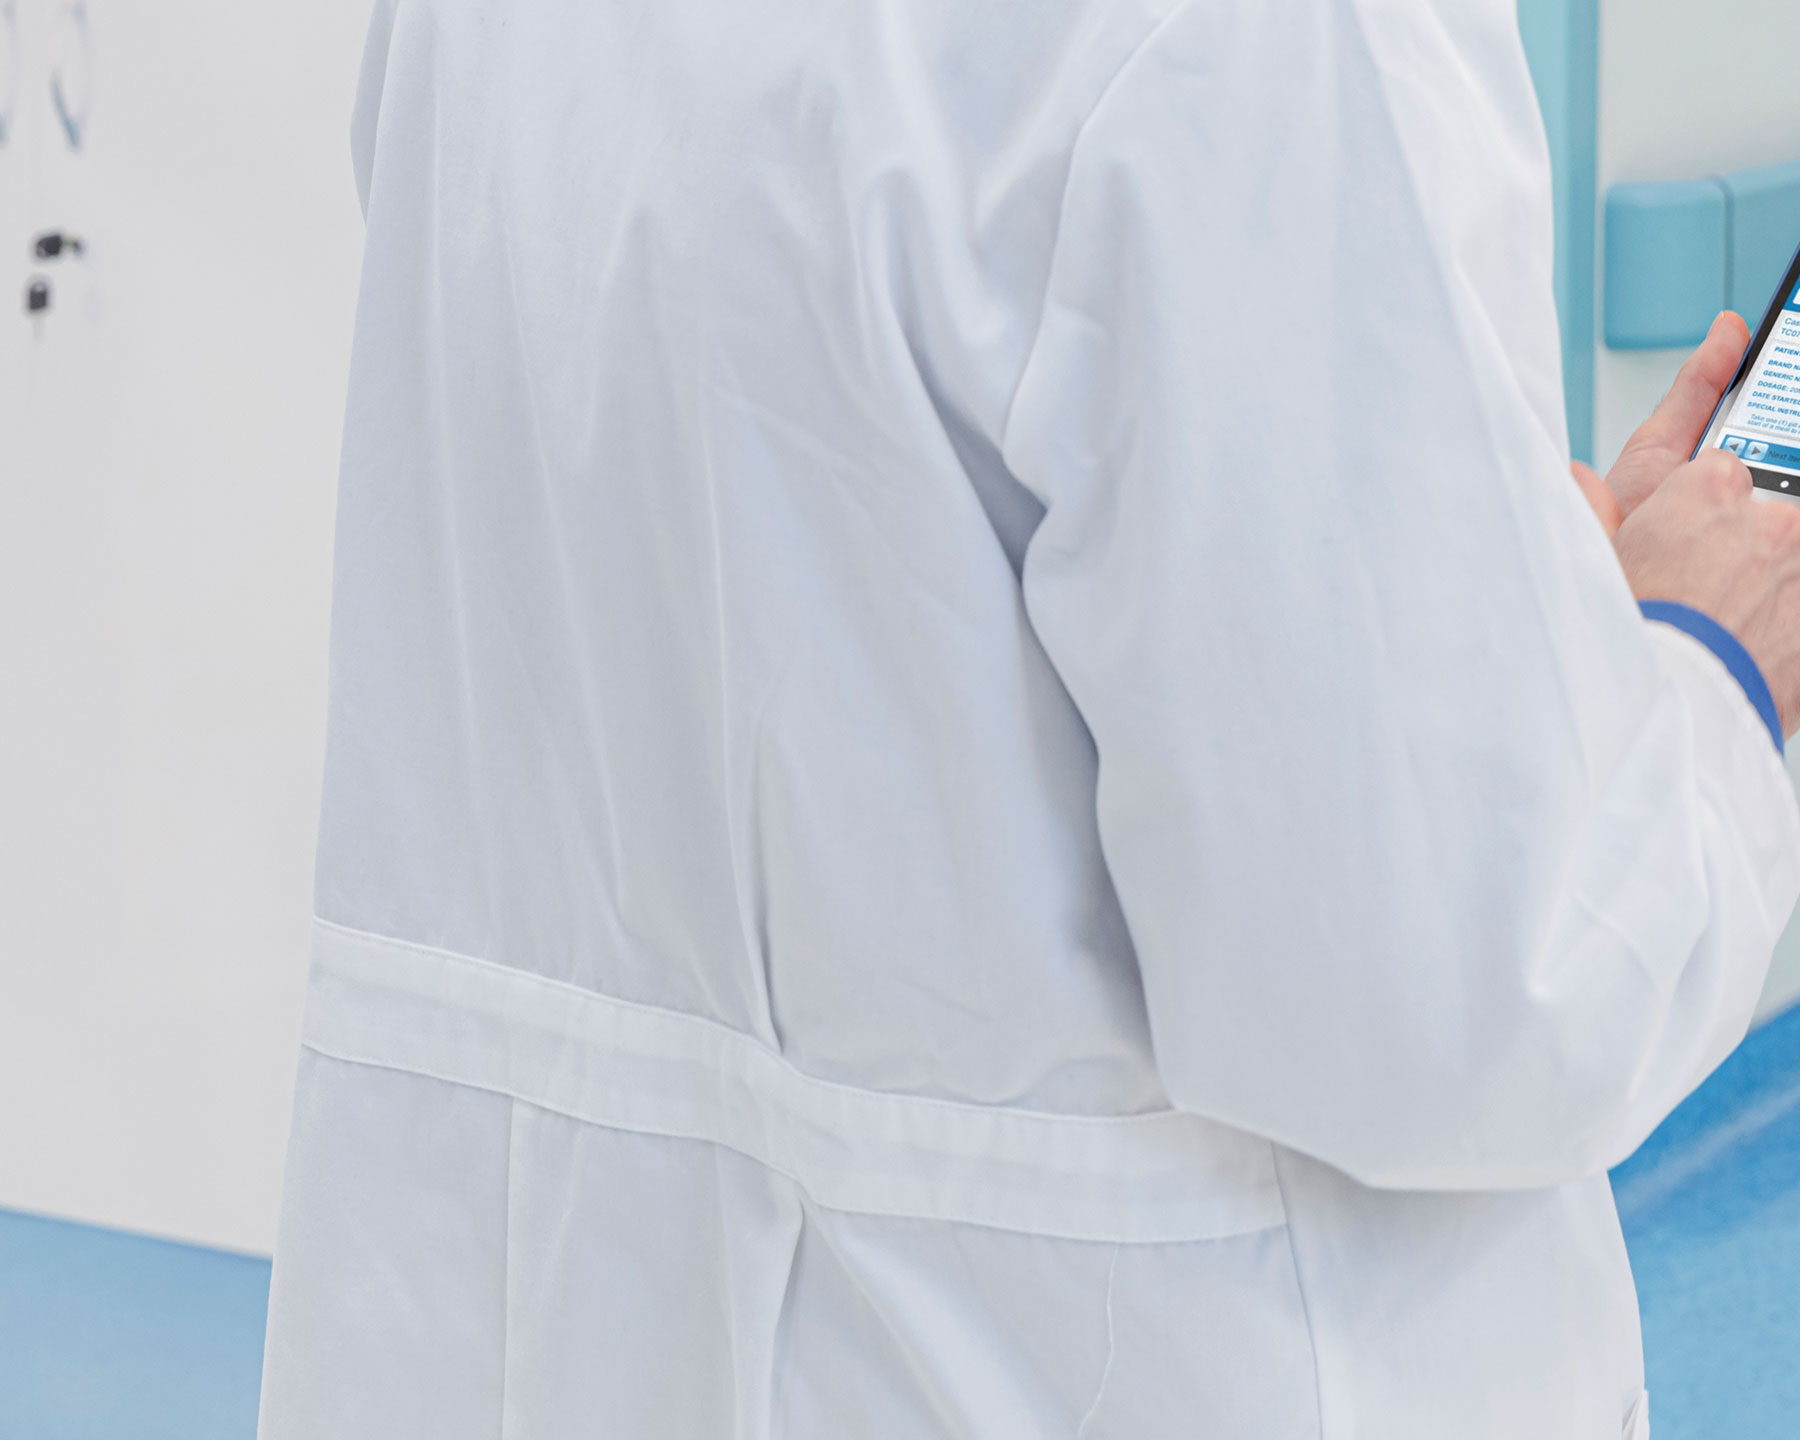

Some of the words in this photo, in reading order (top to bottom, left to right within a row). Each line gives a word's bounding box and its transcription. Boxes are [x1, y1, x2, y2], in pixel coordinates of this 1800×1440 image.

[1767, 359, 1793, 369] BRAND
[1762, 370, 1794, 381] GENERIC
[1757, 380, 1788, 392] DOSAGE:
[1752, 390, 1770, 400] DATE
[1746, 401, 1775, 412] SPECIAL
[1750, 413, 1765, 422] Take
[1768, 450, 1787, 460] Next
